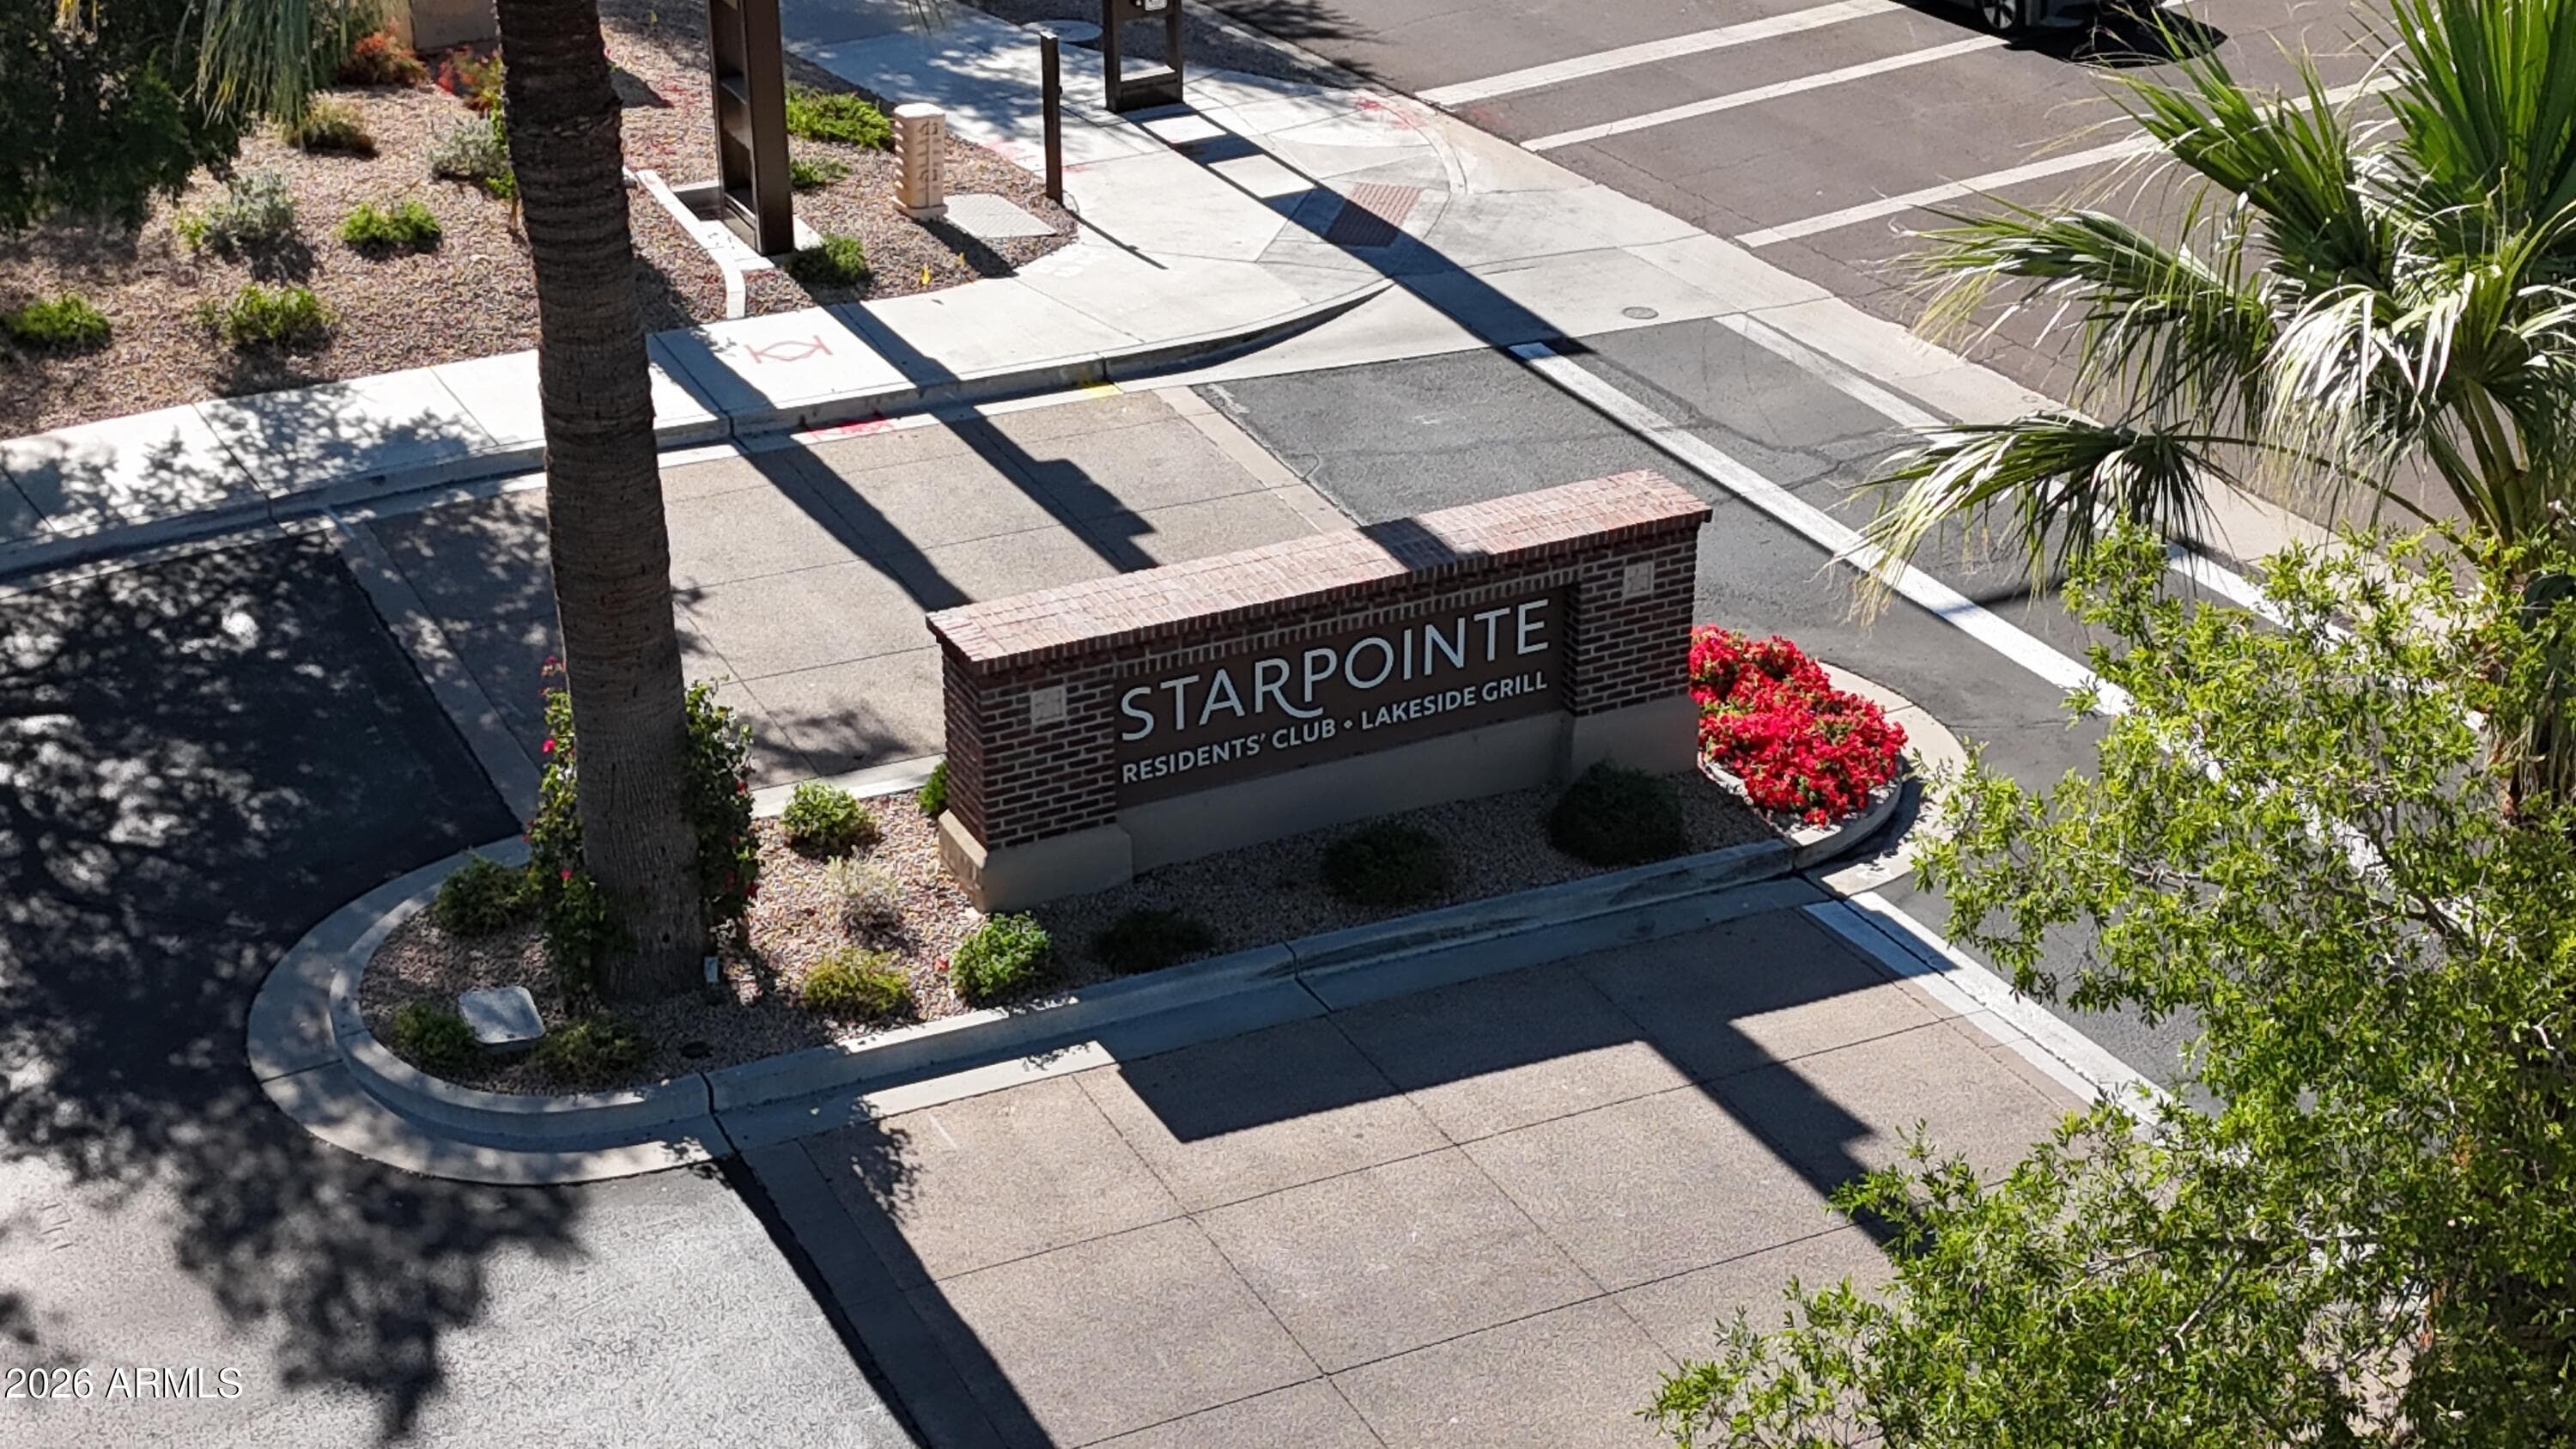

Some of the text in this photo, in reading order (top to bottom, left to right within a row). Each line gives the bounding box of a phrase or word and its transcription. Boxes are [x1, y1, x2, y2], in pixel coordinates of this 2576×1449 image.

[1121, 599, 1548, 741] STARPOINTE
[1272, 718, 1336, 749] CLUB
[1361, 686, 1476, 730] LAKESIDE
[1481, 671, 1548, 701] GRILL
